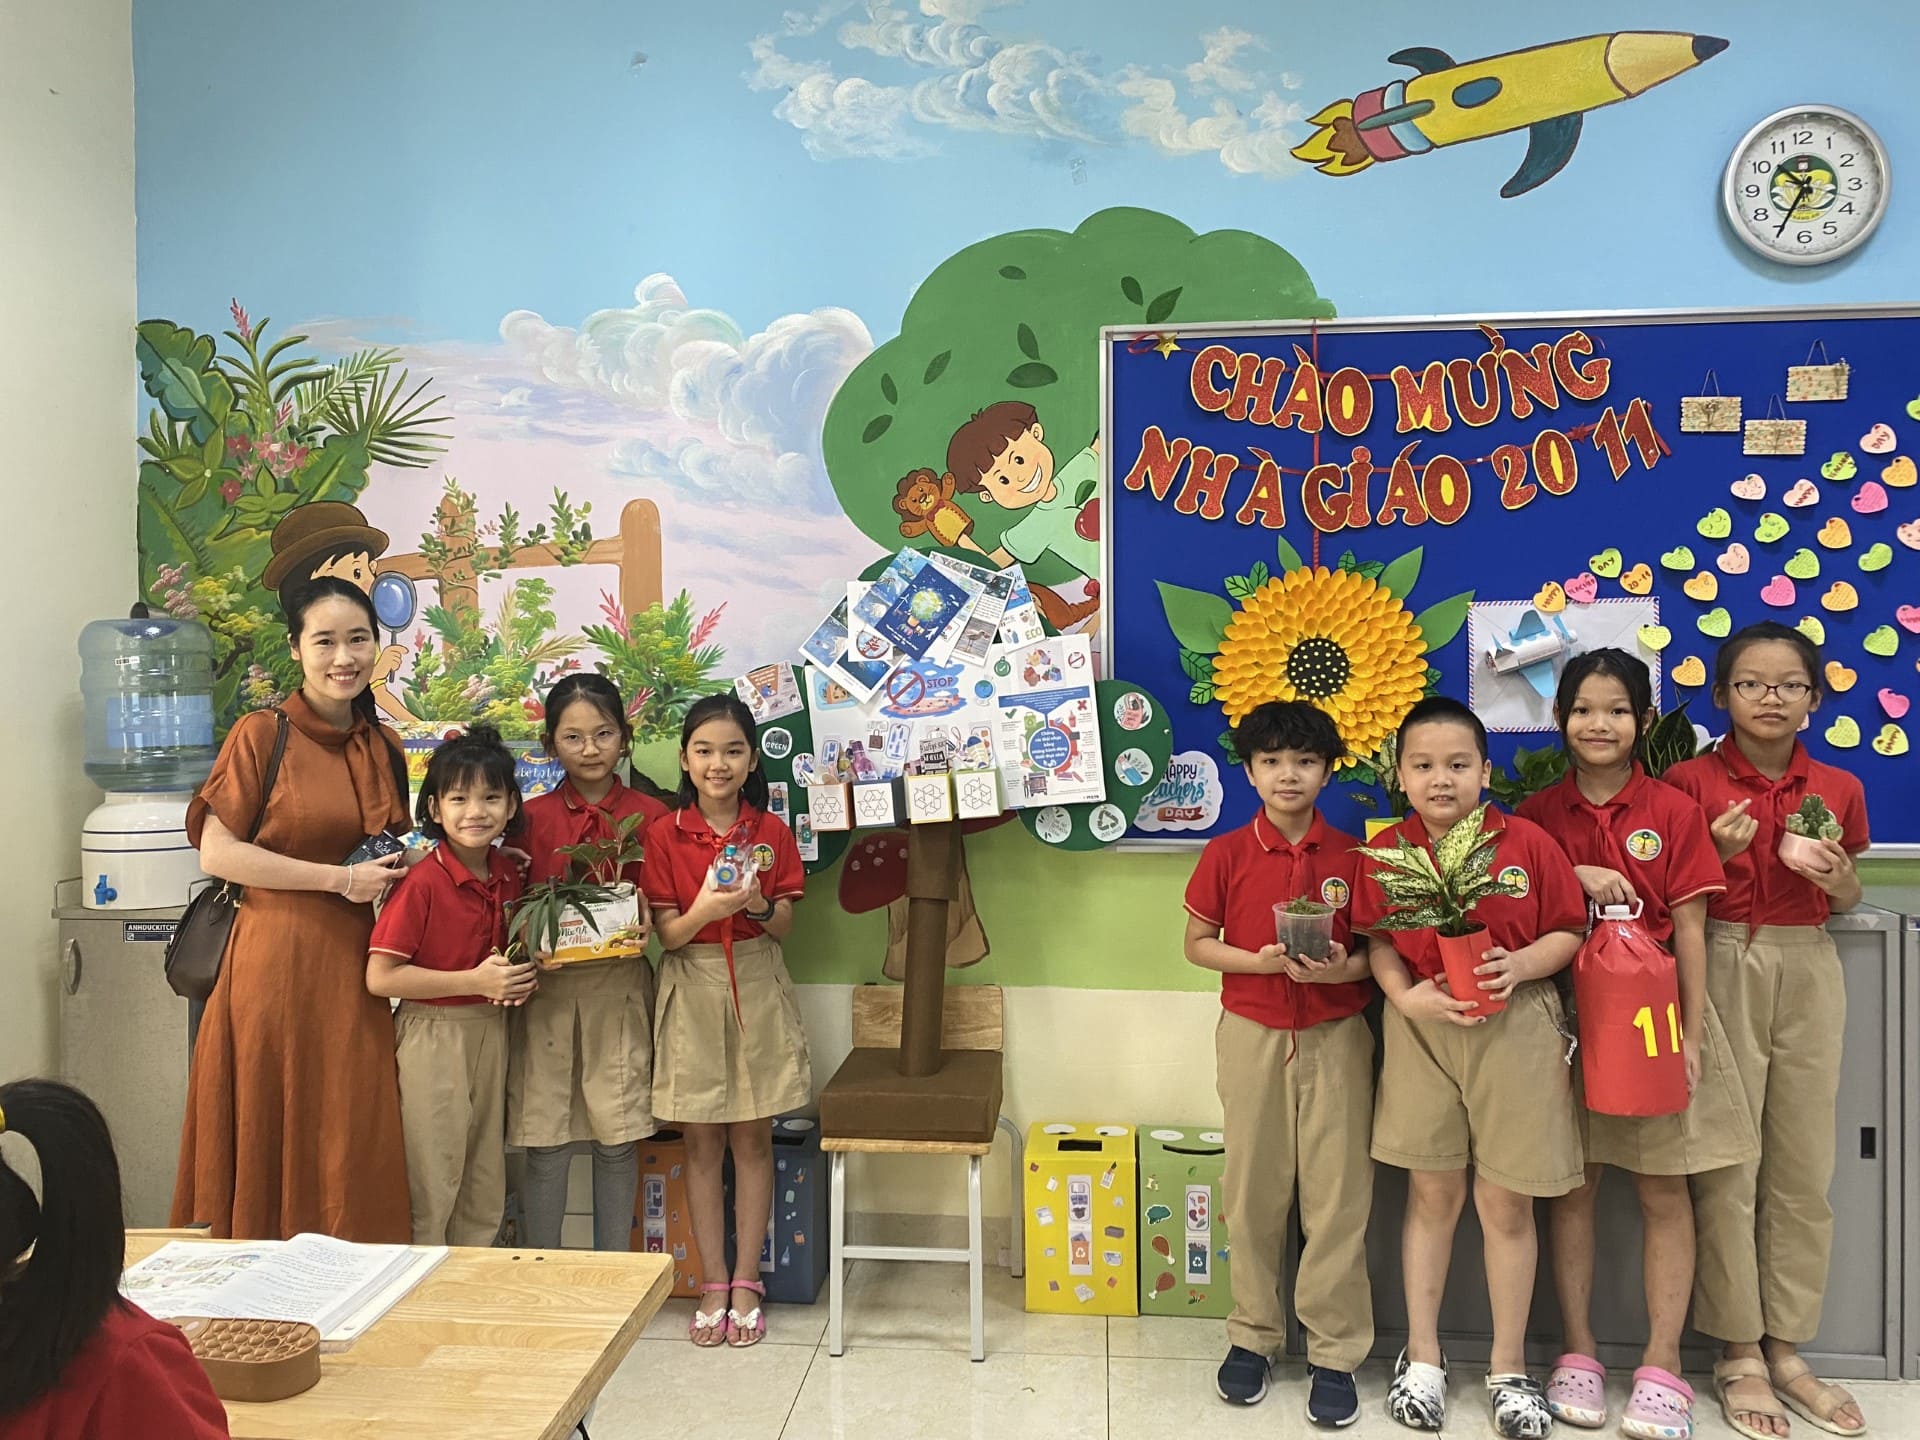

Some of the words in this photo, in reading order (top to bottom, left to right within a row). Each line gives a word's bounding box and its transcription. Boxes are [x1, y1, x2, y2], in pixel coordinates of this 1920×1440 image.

[1793, 131, 1813, 145] 12
[1771, 140, 1785, 154] 11
[1752, 160, 1771, 174] 10
[1839, 153, 1854, 167] 2
[1745, 184, 1760, 197] 9
[1848, 177, 1862, 191] 3
[1753, 208, 1769, 221] 8
[1838, 202, 1855, 215] 4
[1823, 221, 1837, 234] 5
[1797, 231, 1812, 244] 6
[1190, 343, 1373, 437] CHÀO
[1390, 322, 1611, 433] MỪNG
[1597, 556, 1615, 571] DAY
[1541, 586, 1561, 608] HAPPY
[1025, 627, 1042, 640] ECO
[926, 677, 953, 689] STOP
[765, 741, 788, 751] GREEN
[1150, 774, 1208, 806] eachers'
[1165, 808, 1196, 818] DAY
[1632, 1002, 1684, 1058] 11
